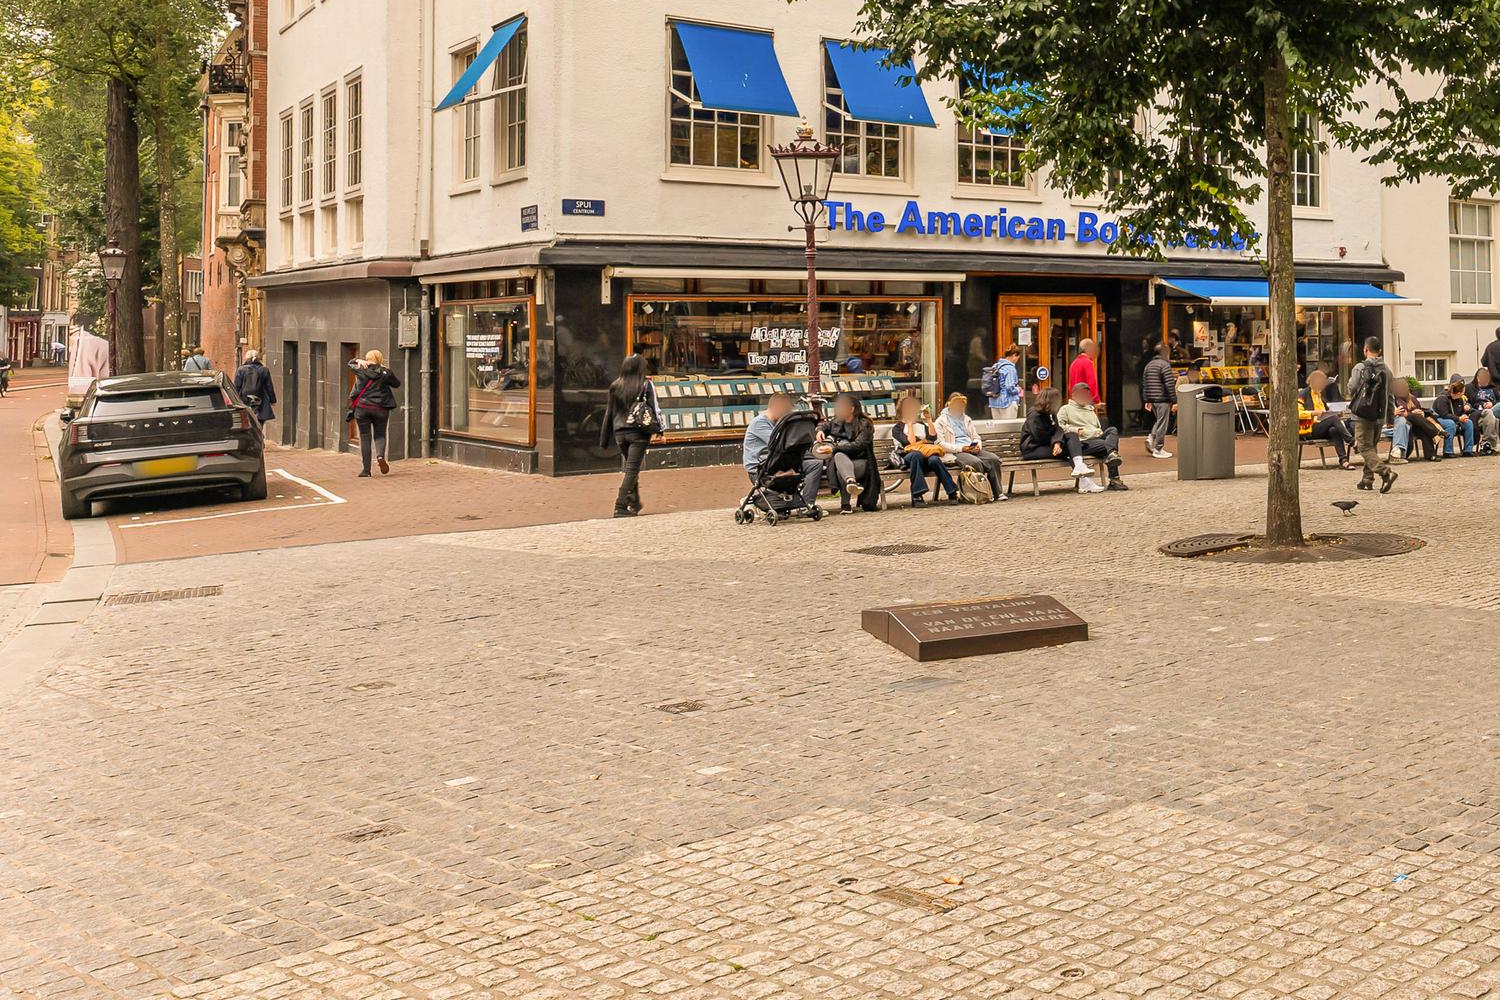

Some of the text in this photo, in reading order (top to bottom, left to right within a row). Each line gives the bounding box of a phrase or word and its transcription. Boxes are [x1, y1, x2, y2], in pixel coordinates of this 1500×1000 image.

[575, 201, 592, 209] SPUI
[822, 200, 885, 232] The
[896, 200, 1066, 241] American
[129, 420, 193, 429] VOLVO
[923, 619, 956, 627] VAN
[961, 615, 984, 623] DE
[1025, 607, 1069, 616] TAAL
[927, 613, 1071, 634] NAAR DE ANDERE
